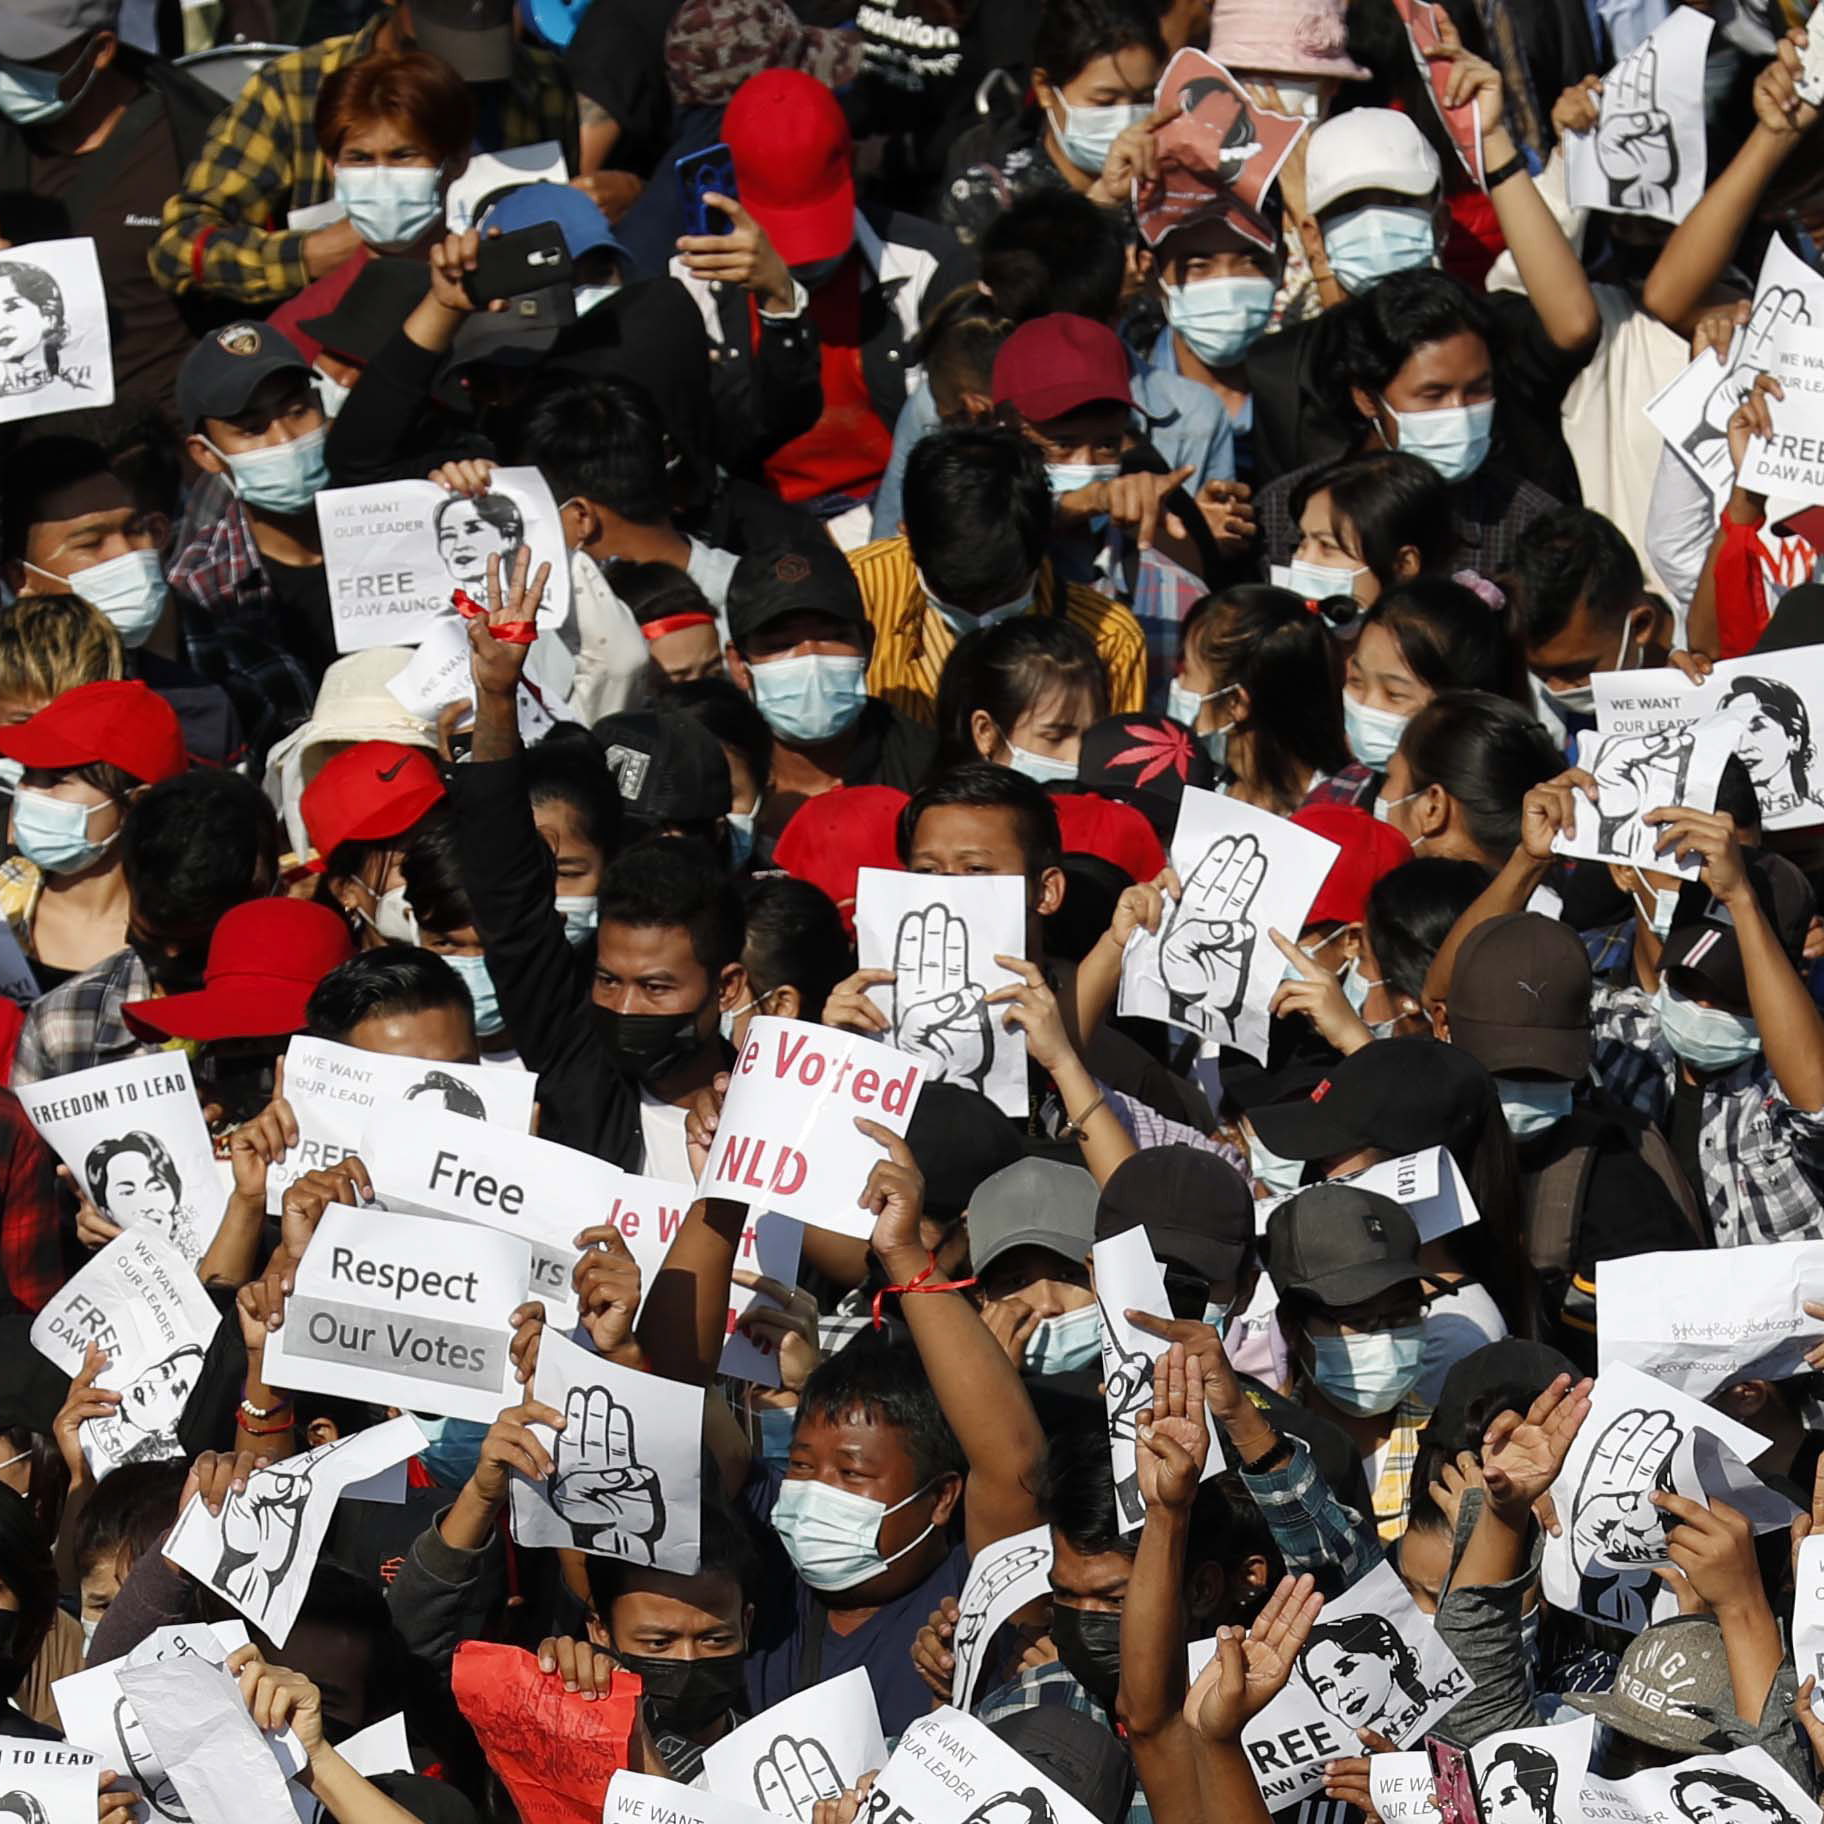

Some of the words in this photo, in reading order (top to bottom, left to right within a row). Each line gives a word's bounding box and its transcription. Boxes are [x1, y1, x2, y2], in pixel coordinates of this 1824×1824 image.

[337, 572, 413, 600] FREE
[31, 1090, 111, 1125] FREEDOM
[117, 1081, 140, 1102] TO
[145, 1073, 187, 1097] LEAD
[773, 1029, 917, 1117] Voted
[429, 1150, 525, 1216] Free
[714, 1133, 807, 1197] NLD
[329, 1248, 480, 1305] Respect
[308, 1312, 376, 1355] Our
[386, 1322, 488, 1374] Votes
[12, 1749, 36, 1764] TO
[42, 1752, 95, 1766] LEAD
[617, 1795, 650, 1819] WE
